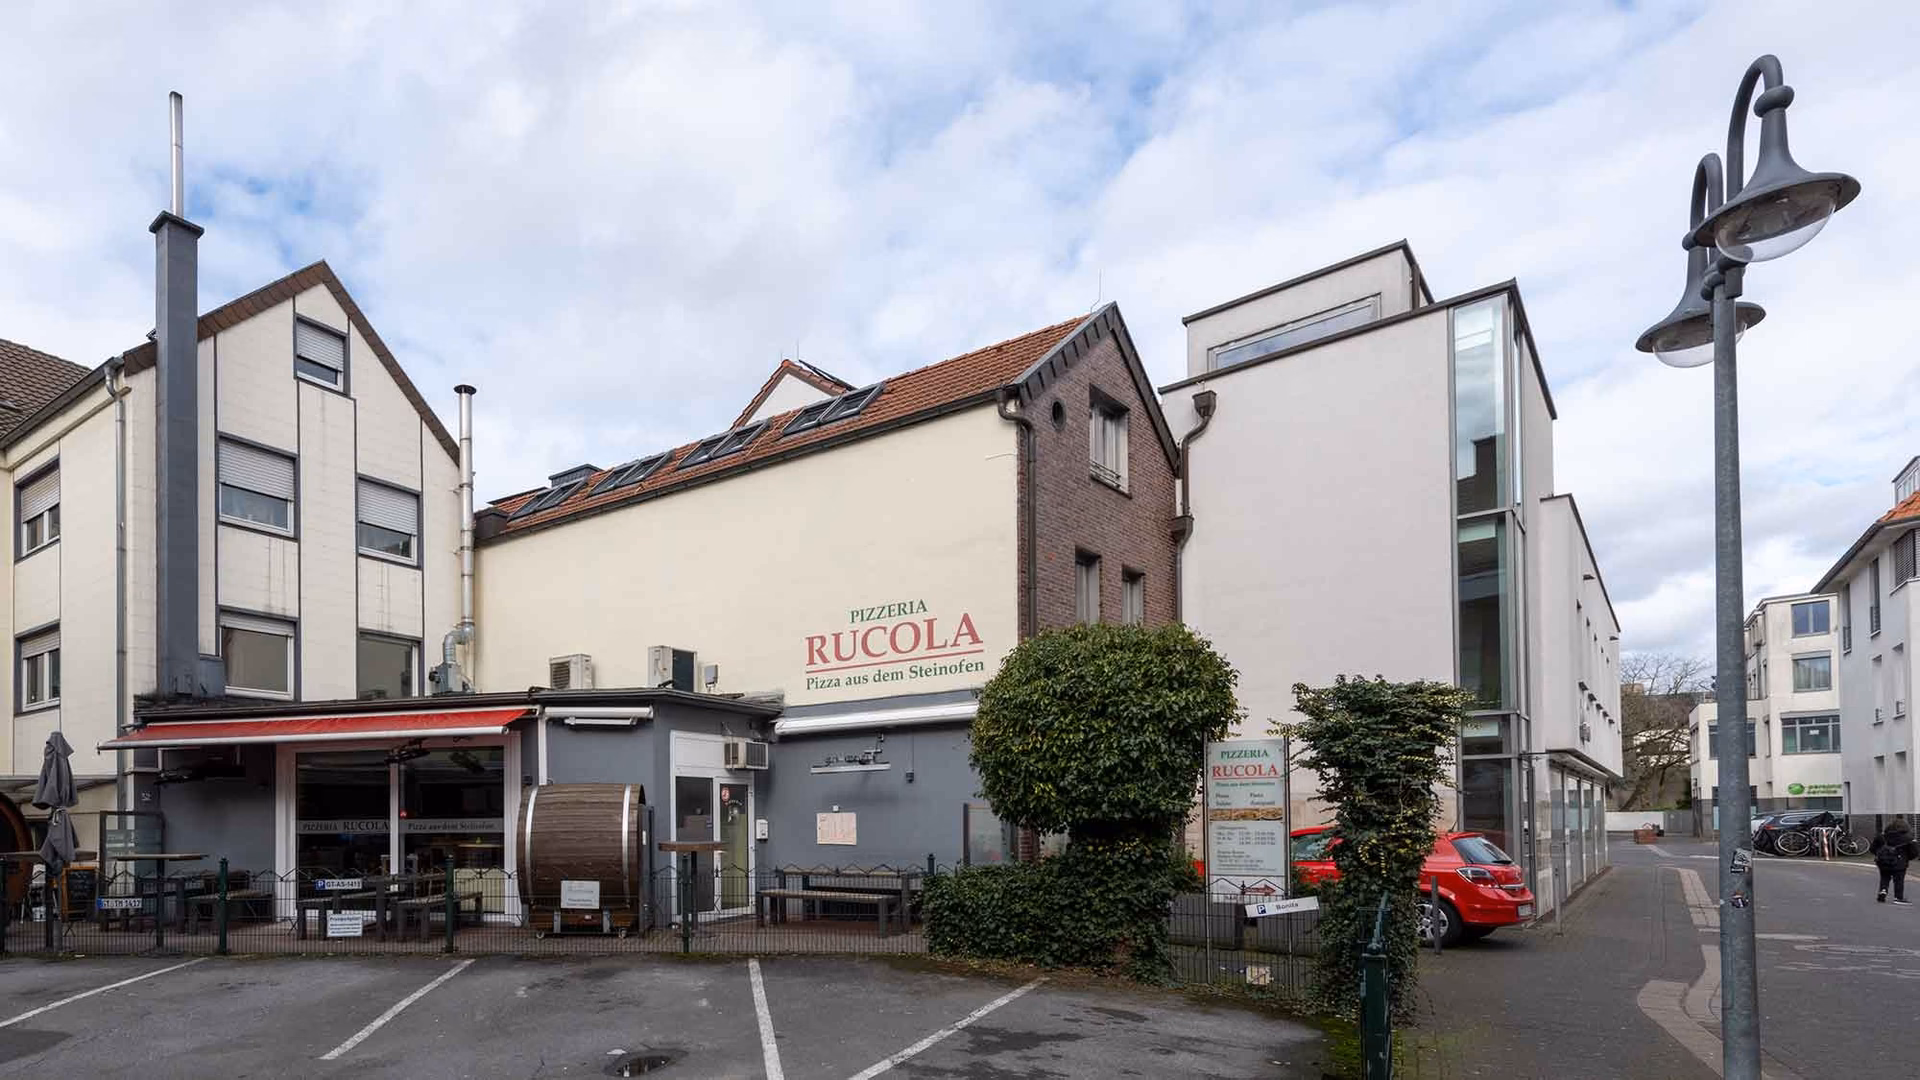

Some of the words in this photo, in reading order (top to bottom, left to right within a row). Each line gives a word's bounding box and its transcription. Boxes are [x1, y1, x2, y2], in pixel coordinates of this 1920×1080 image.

[850, 599, 928, 623] PIZZERIA
[805, 612, 984, 666] RUCOLA
[806, 677, 841, 690] Pizza
[845, 674, 869, 686] aus
[873, 669, 904, 683] dem
[908, 658, 984, 679] Steinofen
[1220, 749, 1270, 759] PIZZERIA
[1212, 763, 1279, 777] RUCOLA
[343, 820, 390, 831] RUCOLA
